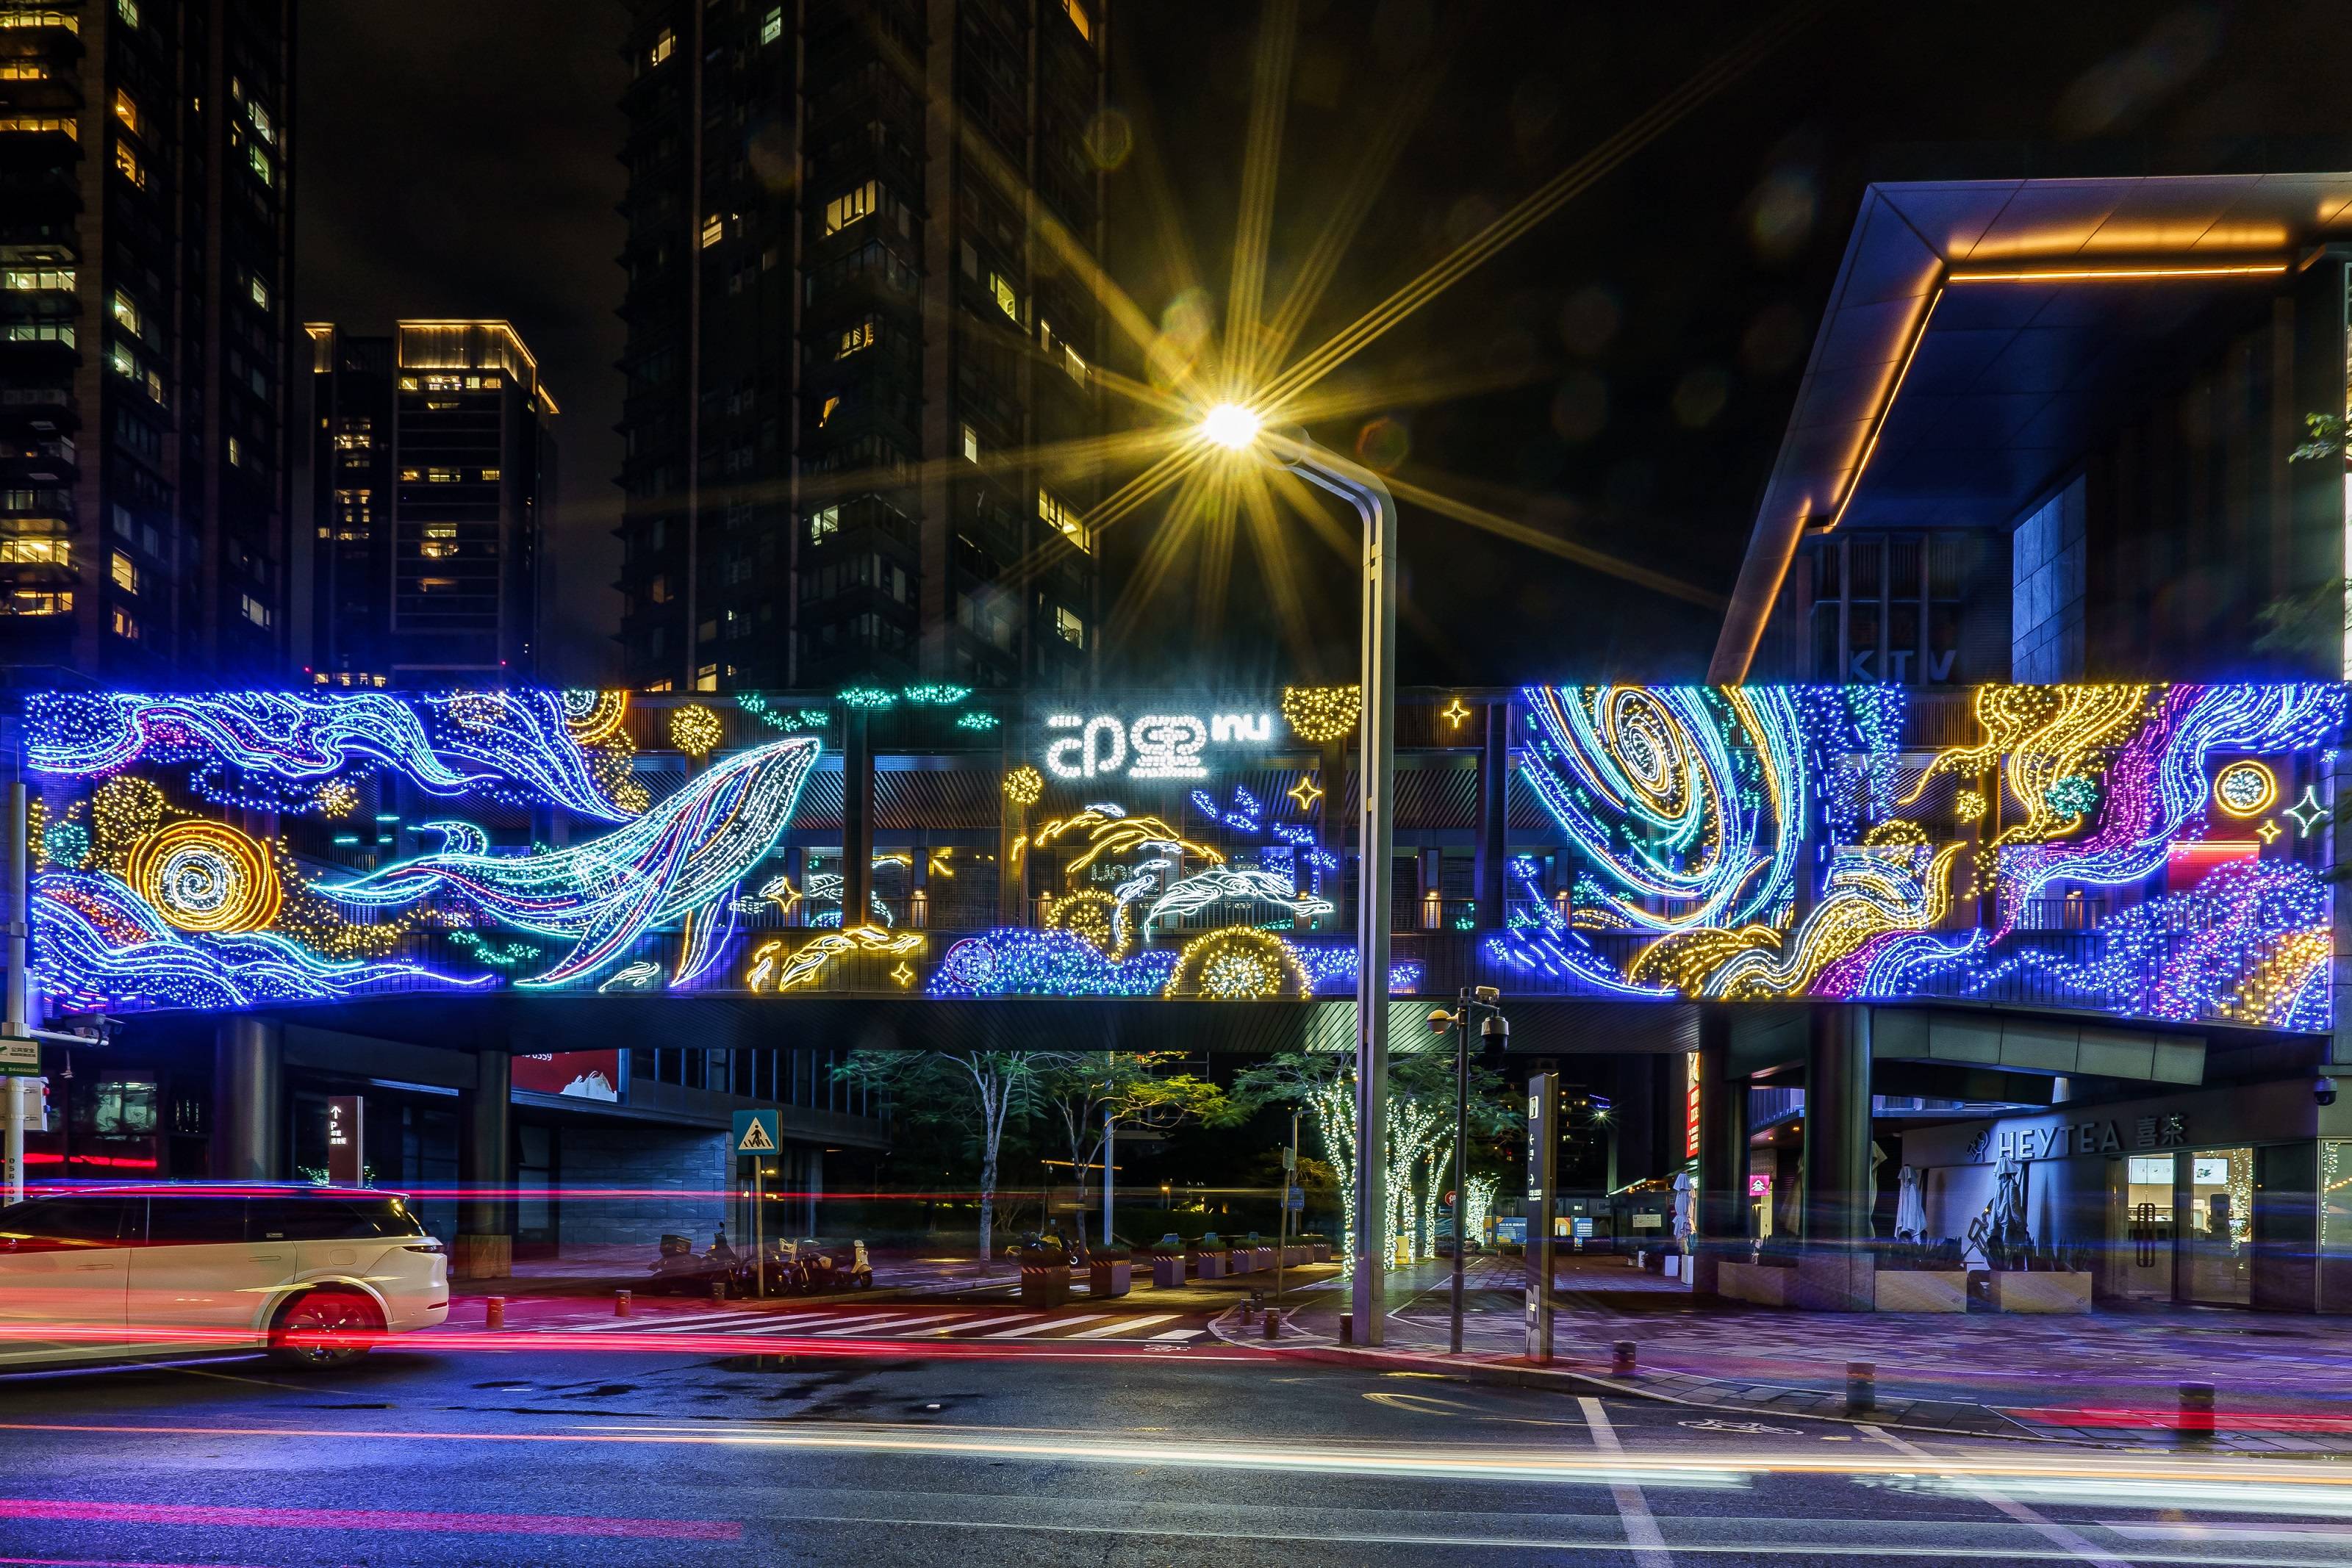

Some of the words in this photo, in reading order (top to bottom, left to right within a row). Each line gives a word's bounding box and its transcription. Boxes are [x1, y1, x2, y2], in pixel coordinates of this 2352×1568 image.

[1849, 650, 1957, 680] KTV
[330, 1121, 337, 1130] P
[1998, 1120, 2121, 1159] HEYTEA
[2136, 1112, 2186, 1148] 喜茶
